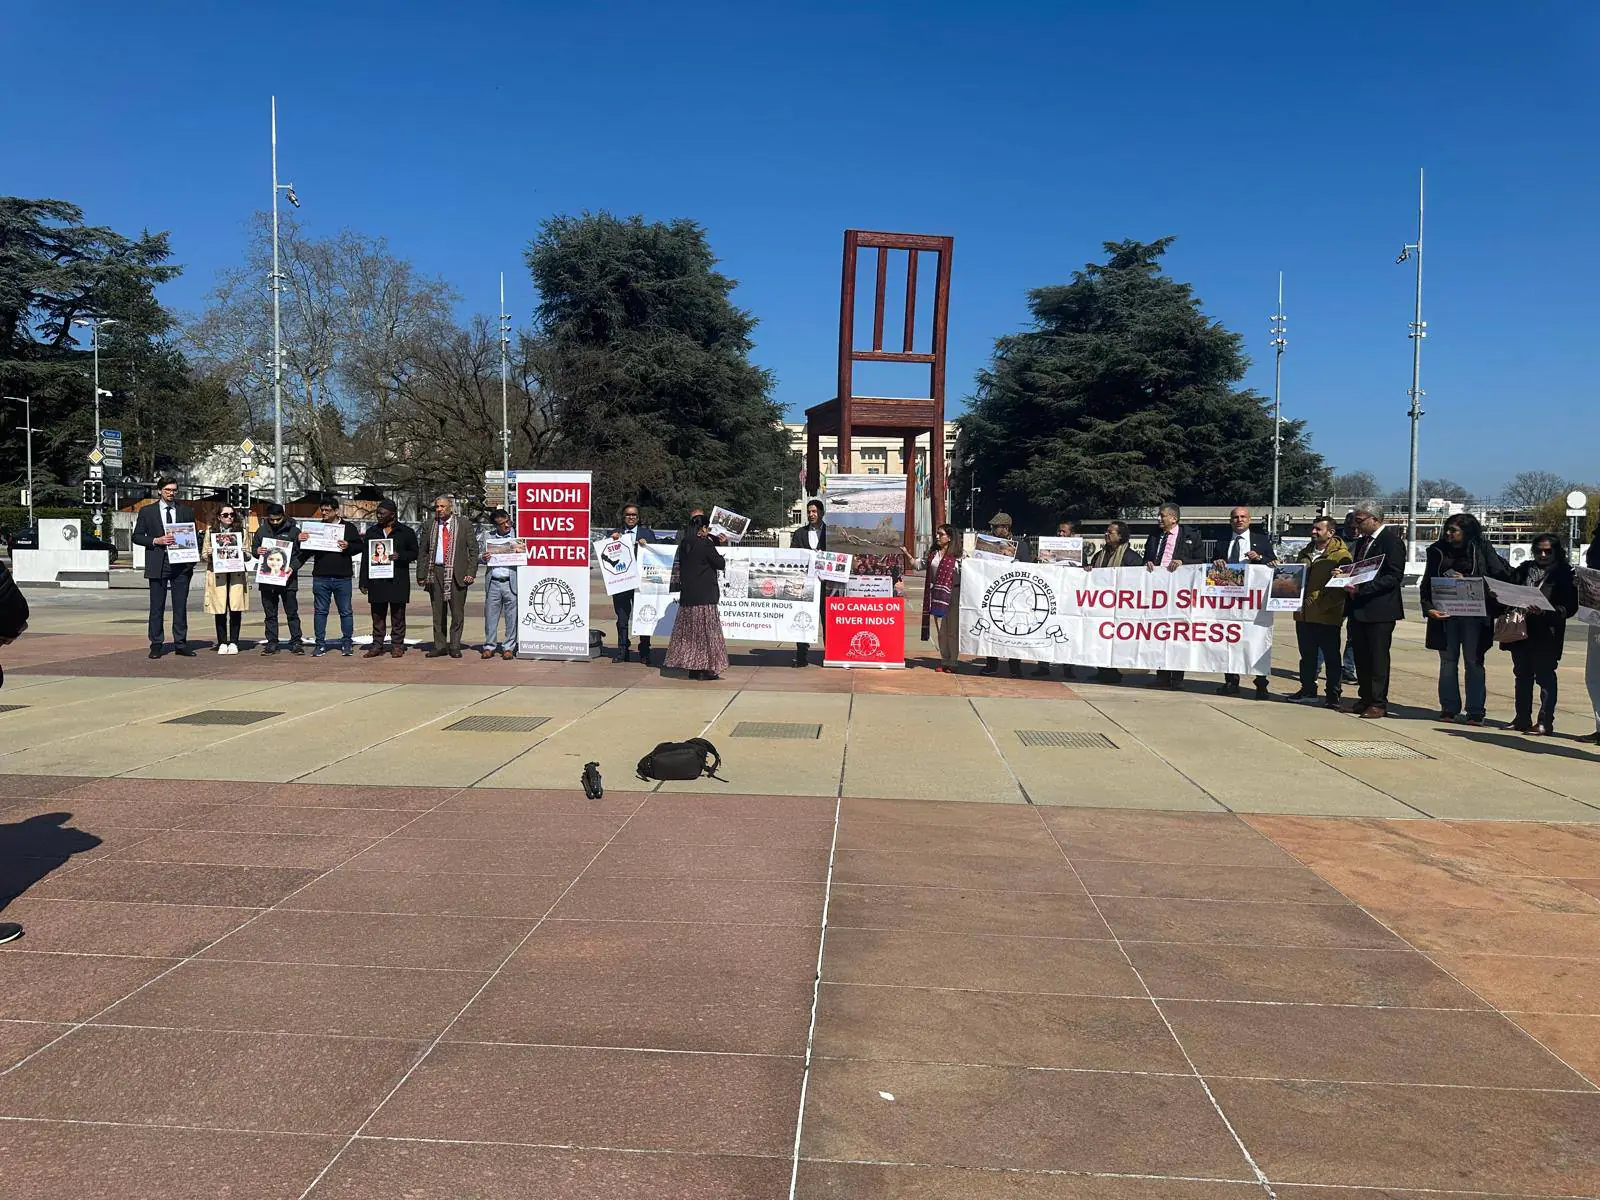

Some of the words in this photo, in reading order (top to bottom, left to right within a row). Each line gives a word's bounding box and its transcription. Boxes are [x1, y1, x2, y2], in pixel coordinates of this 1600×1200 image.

[526, 488, 581, 503] SINDHI
[533, 517, 575, 532] LIVES
[526, 546, 586, 561] MATTER
[607, 543, 622, 553] STOP
[528, 584, 539, 607] WORLD
[981, 580, 1000, 609] WORLD
[1001, 571, 1031, 583] SINDHI
[1032, 575, 1057, 615] CONGRESS
[1075, 589, 1168, 610] WORLD
[1175, 589, 1262, 610] SINDHI
[738, 600, 749, 608] ON
[830, 603, 845, 611] NO
[847, 603, 884, 611] CANALS
[886, 603, 901, 611] ON
[723, 611, 761, 619] DEVASTATE
[835, 617, 863, 625] RIVER
[865, 617, 895, 625] INDUS
[720, 620, 741, 628] Sindhi
[742, 621, 772, 630] Congress
[1098, 621, 1242, 644] CONGRESS
